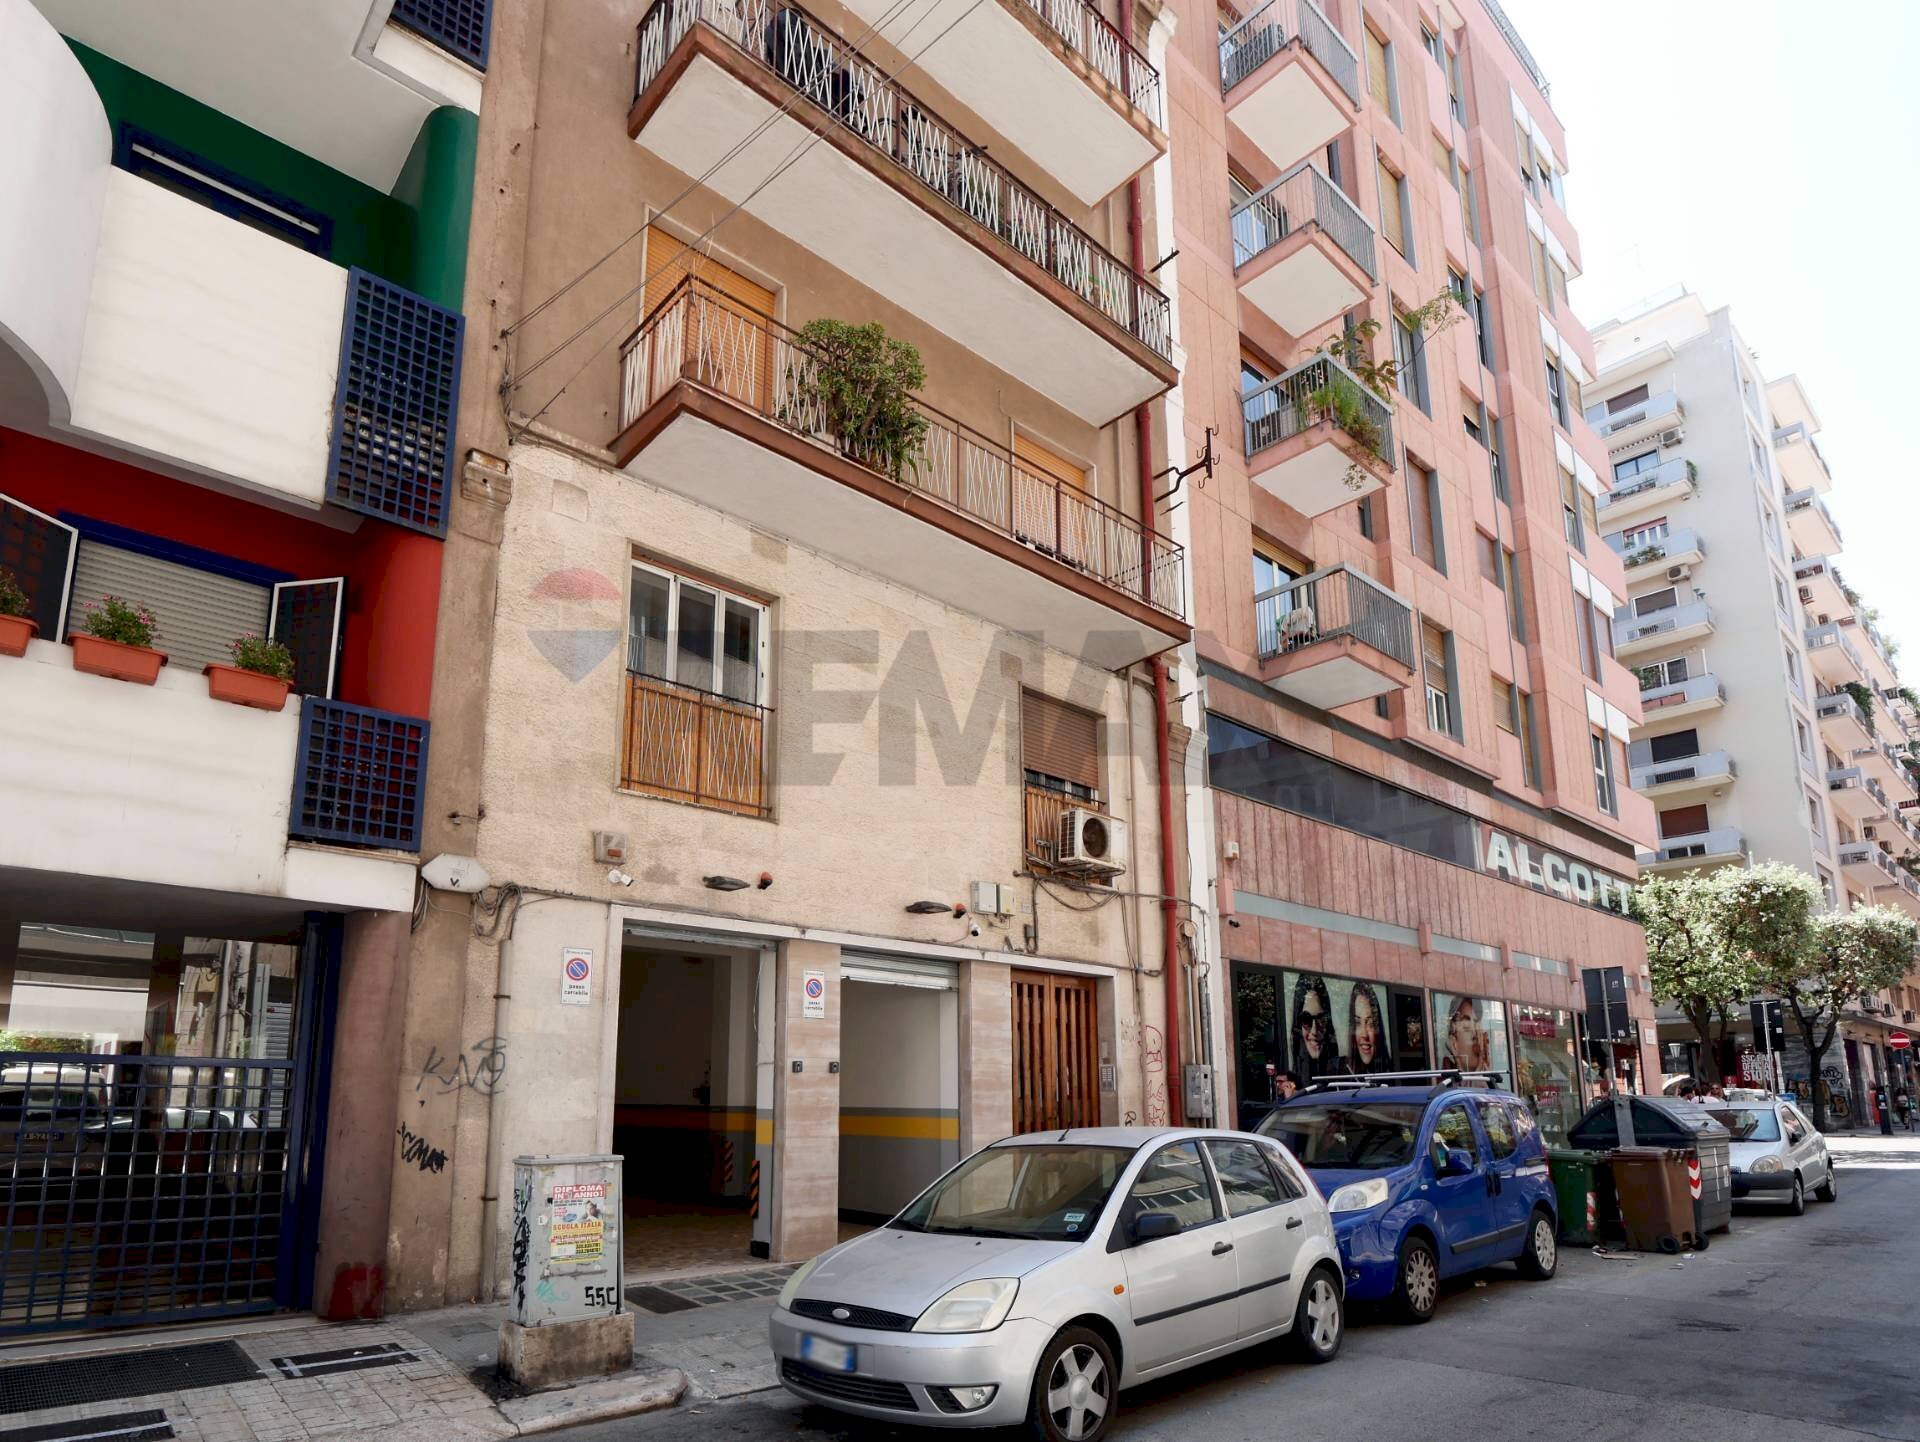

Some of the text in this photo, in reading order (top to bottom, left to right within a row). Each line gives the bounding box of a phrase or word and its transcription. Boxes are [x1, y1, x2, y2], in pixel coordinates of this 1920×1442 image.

[1485, 831, 1632, 915] ALCOTT
[554, 1184, 603, 1193] DIPLOMA
[554, 1192, 564, 1200] IN
[573, 1190, 603, 1199] ANNO!
[553, 1221, 602, 1231] SCUOLA ITALIA
